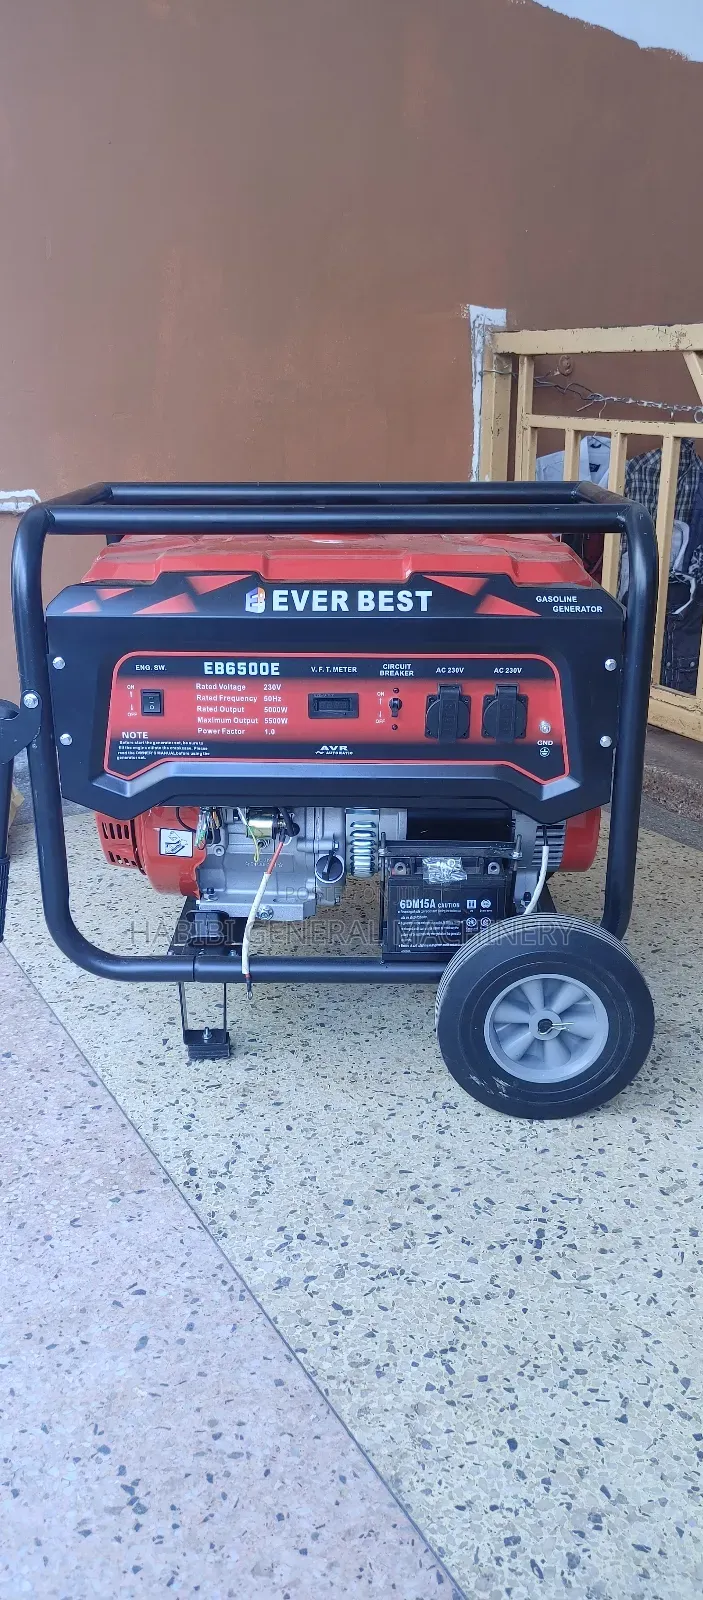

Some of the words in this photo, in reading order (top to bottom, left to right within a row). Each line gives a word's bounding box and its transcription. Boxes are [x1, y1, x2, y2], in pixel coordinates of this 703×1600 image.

[272, 590, 350, 612] EVER
[358, 590, 432, 612] BEST
[203, 662, 280, 676] EB6500E
[196, 682, 218, 690] Rated
[218, 682, 246, 692] Voltage
[219, 694, 258, 703] Frequency
[219, 706, 244, 714] Output
[233, 716, 259, 725] Output
[400, 899, 436, 909] 6DM15A
